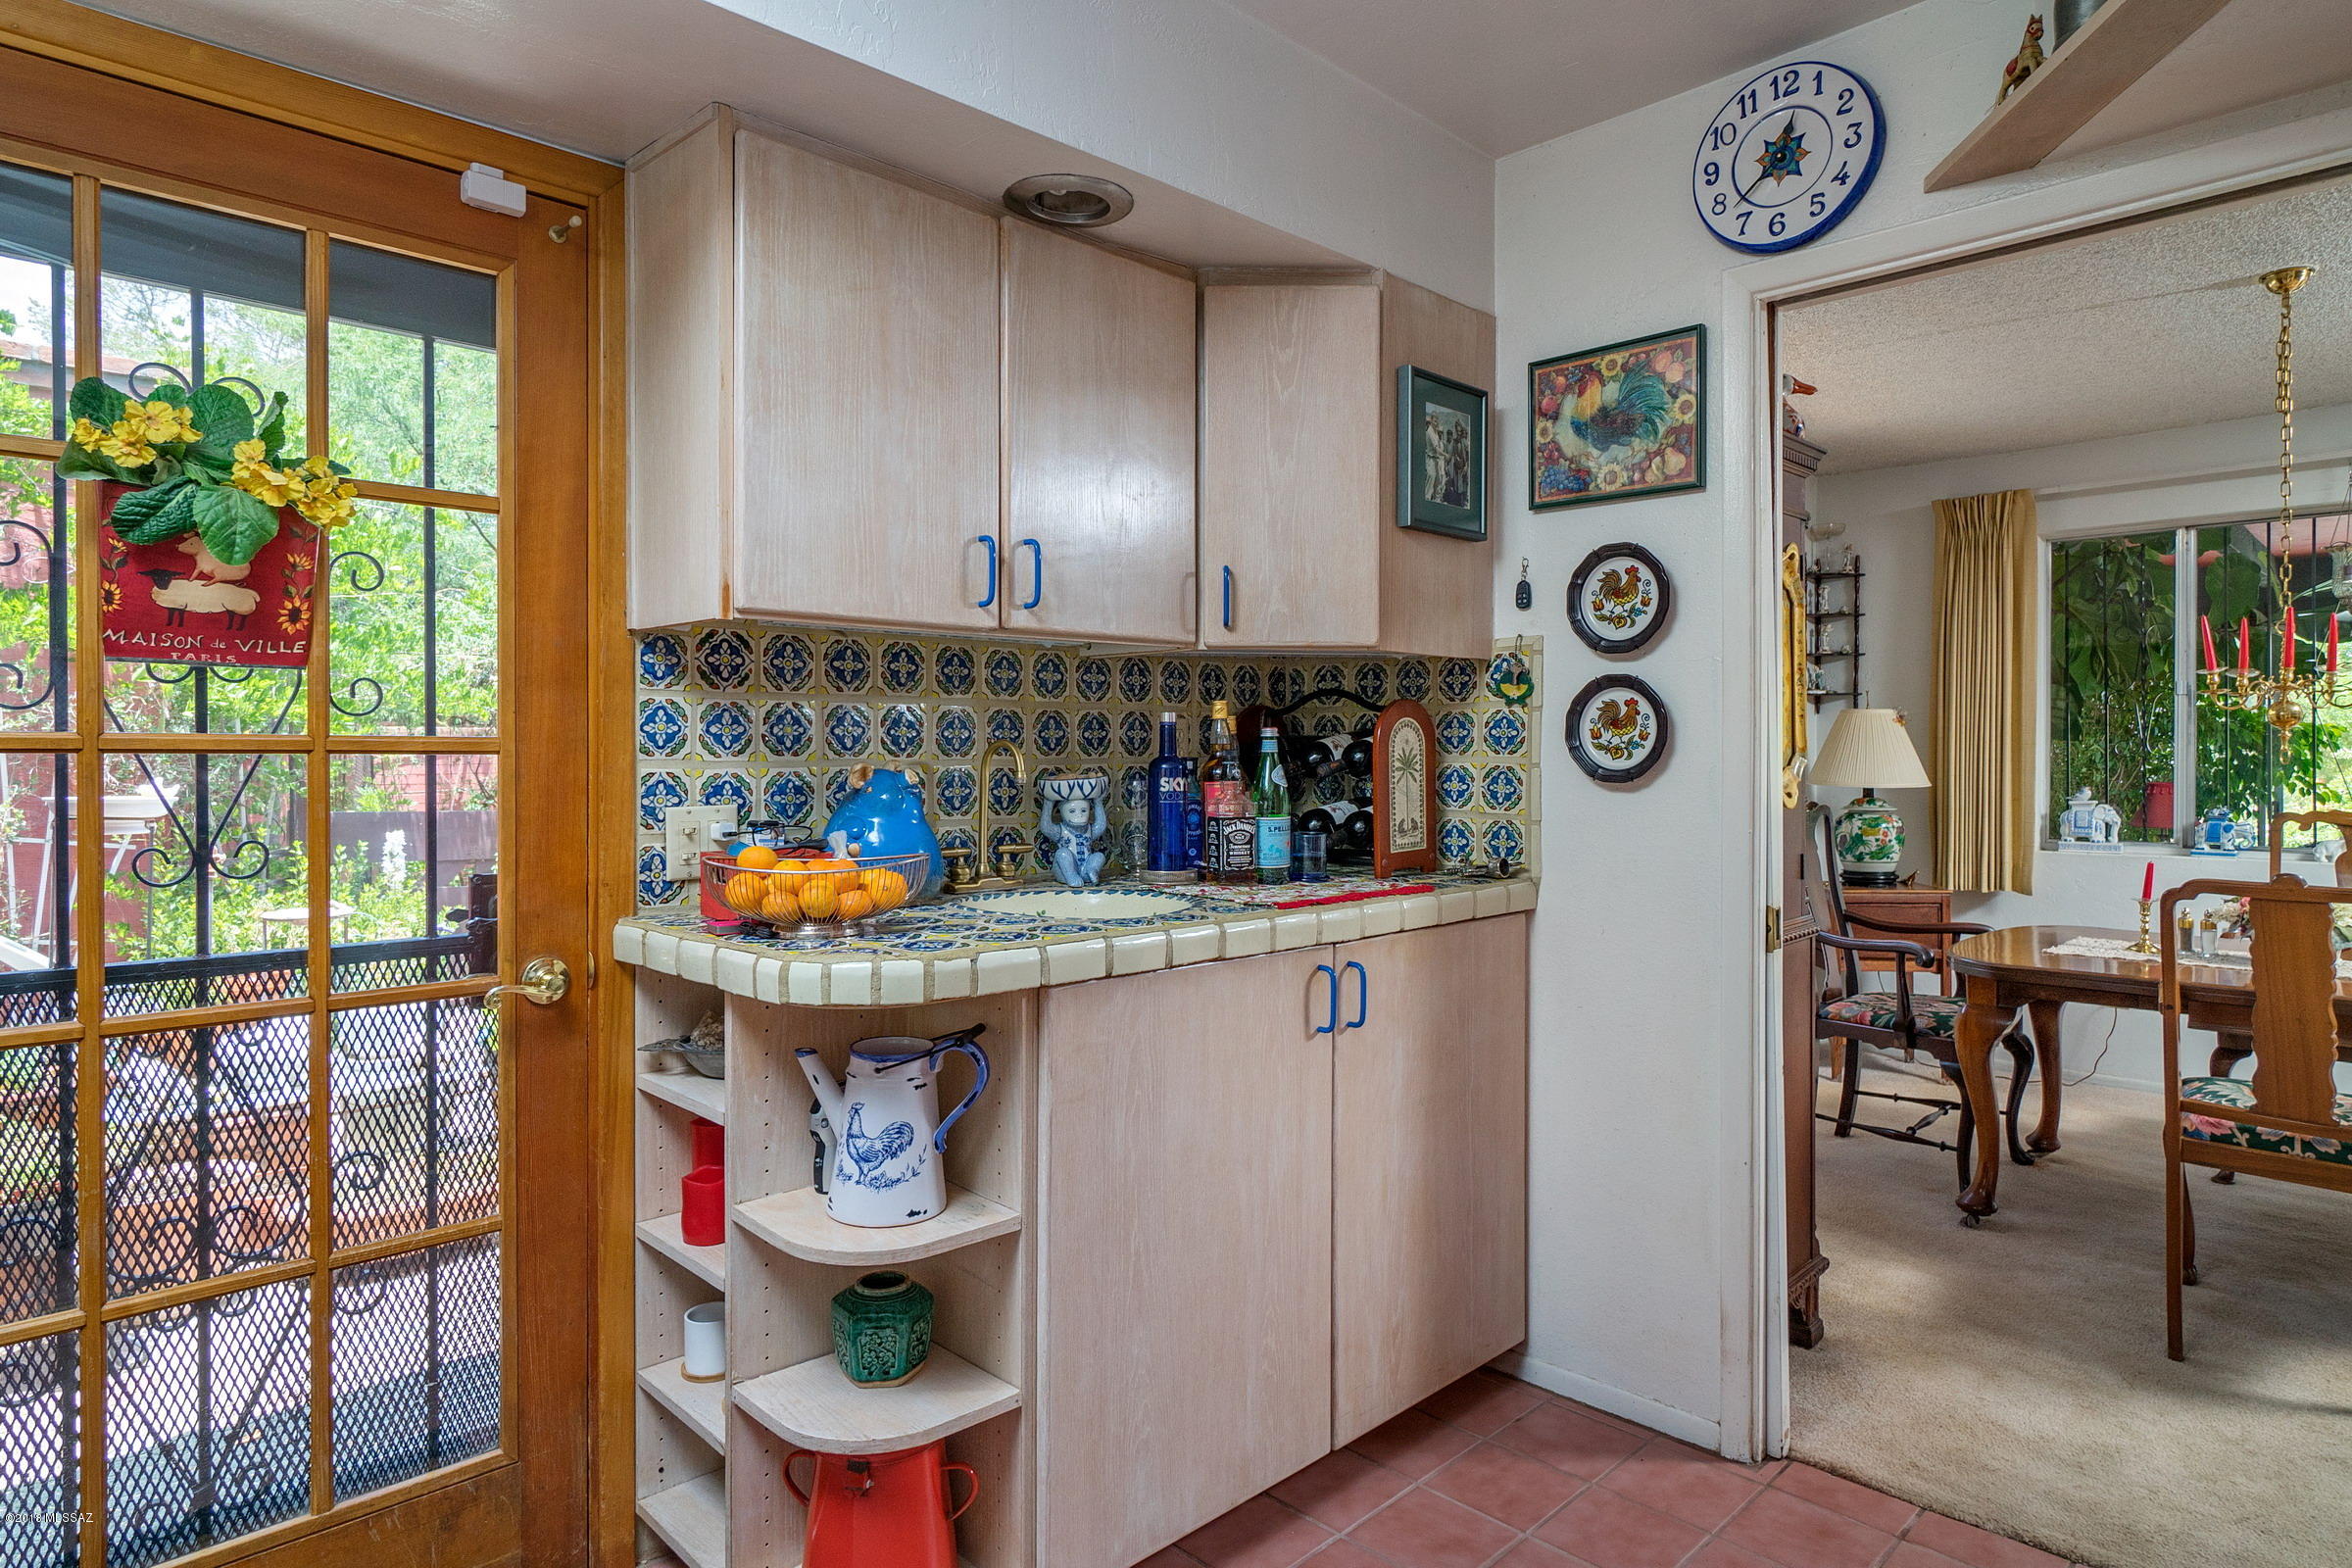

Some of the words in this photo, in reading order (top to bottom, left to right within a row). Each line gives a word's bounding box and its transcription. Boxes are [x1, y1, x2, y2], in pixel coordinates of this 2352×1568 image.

[1769, 70, 1800, 101] 12
[1812, 70, 1824, 96] 1
[1737, 88, 1758, 120] 11
[1836, 87, 1855, 116] 2
[1709, 122, 1737, 151] 10
[1843, 122, 1863, 149] 3
[1703, 162, 1720, 186] 9
[1830, 160, 1851, 186] 4
[1711, 192, 1727, 216] 8
[1809, 192, 1826, 218] 5
[1735, 210, 1753, 237] 7
[1768, 212, 1787, 237] 6
[102, 627, 205, 650] MAISON
[210, 638, 226, 649] de
[234, 639, 307, 655] VILLE
[171, 652, 237, 663] PARIS
[1159, 792, 1184, 801] VOD
